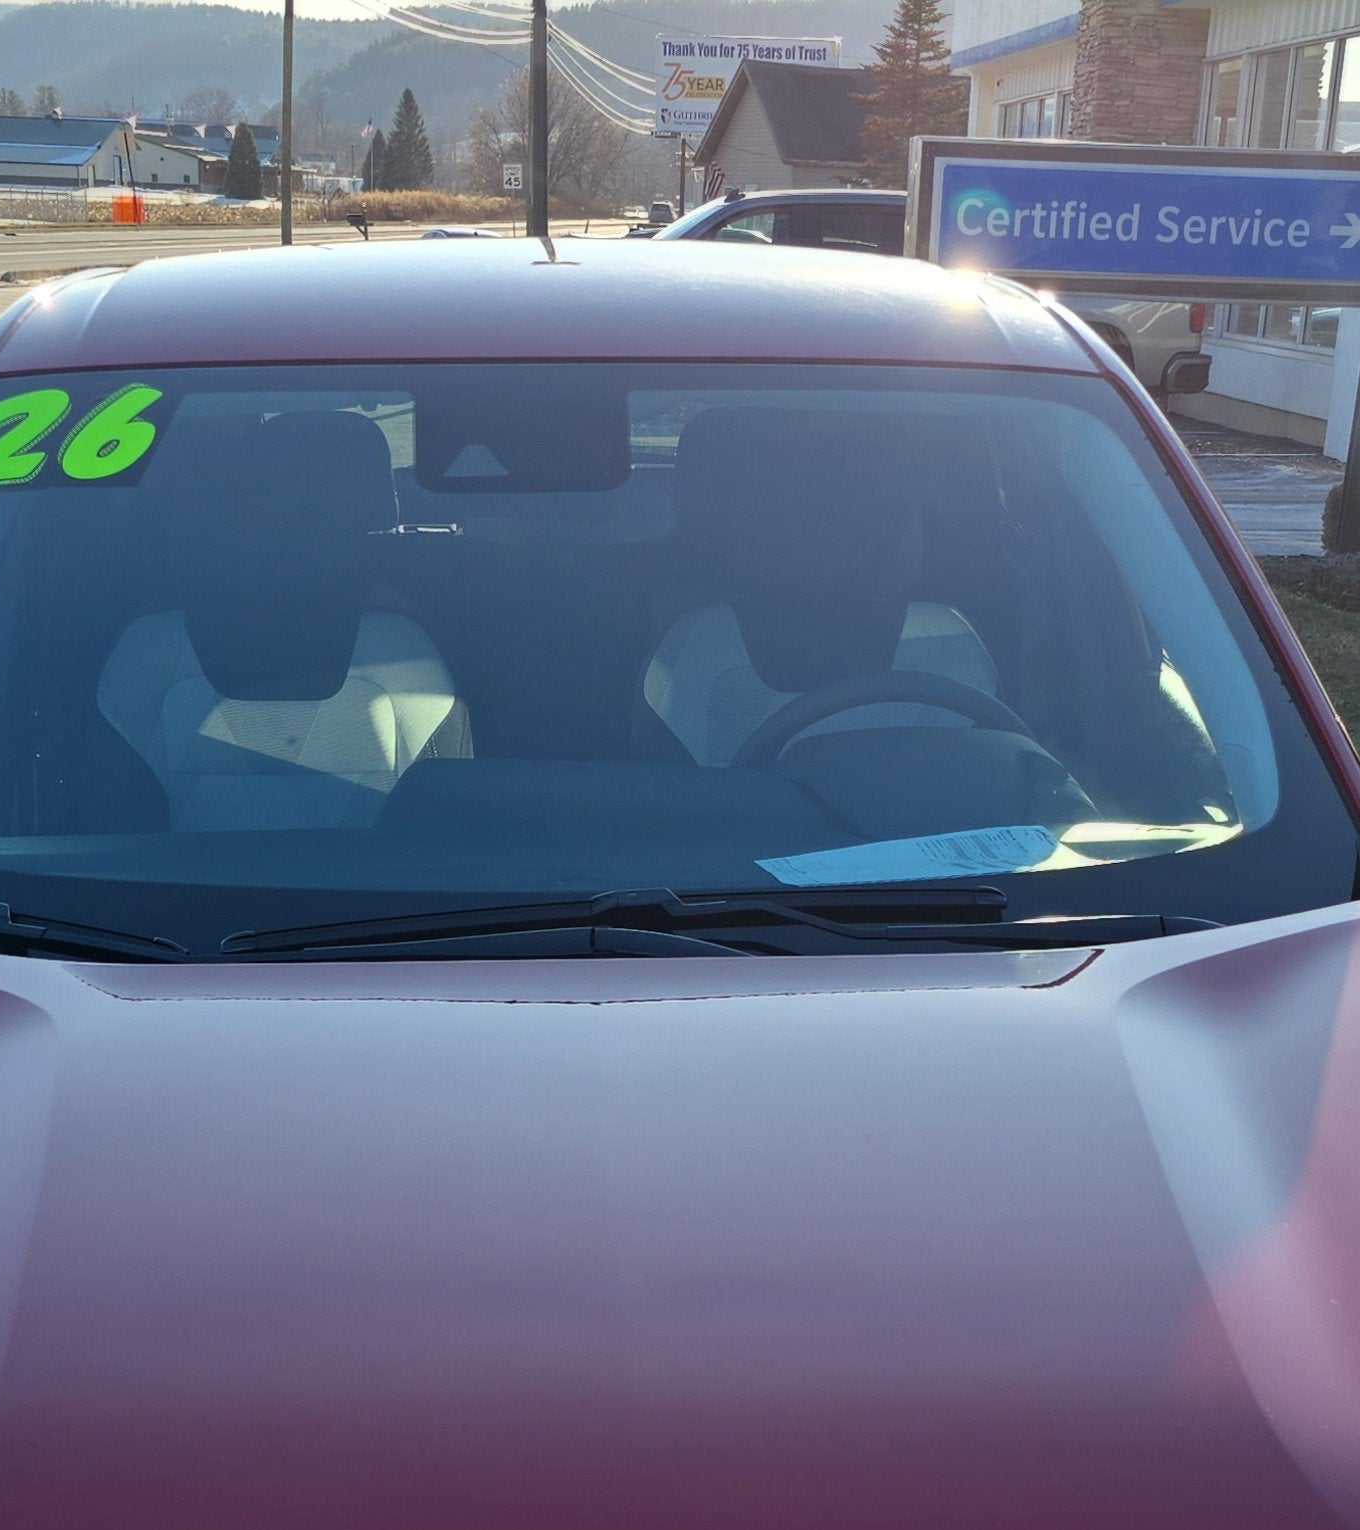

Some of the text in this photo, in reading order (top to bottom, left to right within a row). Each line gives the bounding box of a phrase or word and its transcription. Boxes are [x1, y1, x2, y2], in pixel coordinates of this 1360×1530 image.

[662, 41, 827, 61] Thank You for 75 Years of Trust
[662, 62, 724, 101] 75 YEAR
[505, 177, 520, 187] 45
[955, 198, 1310, 248] Certified Service
